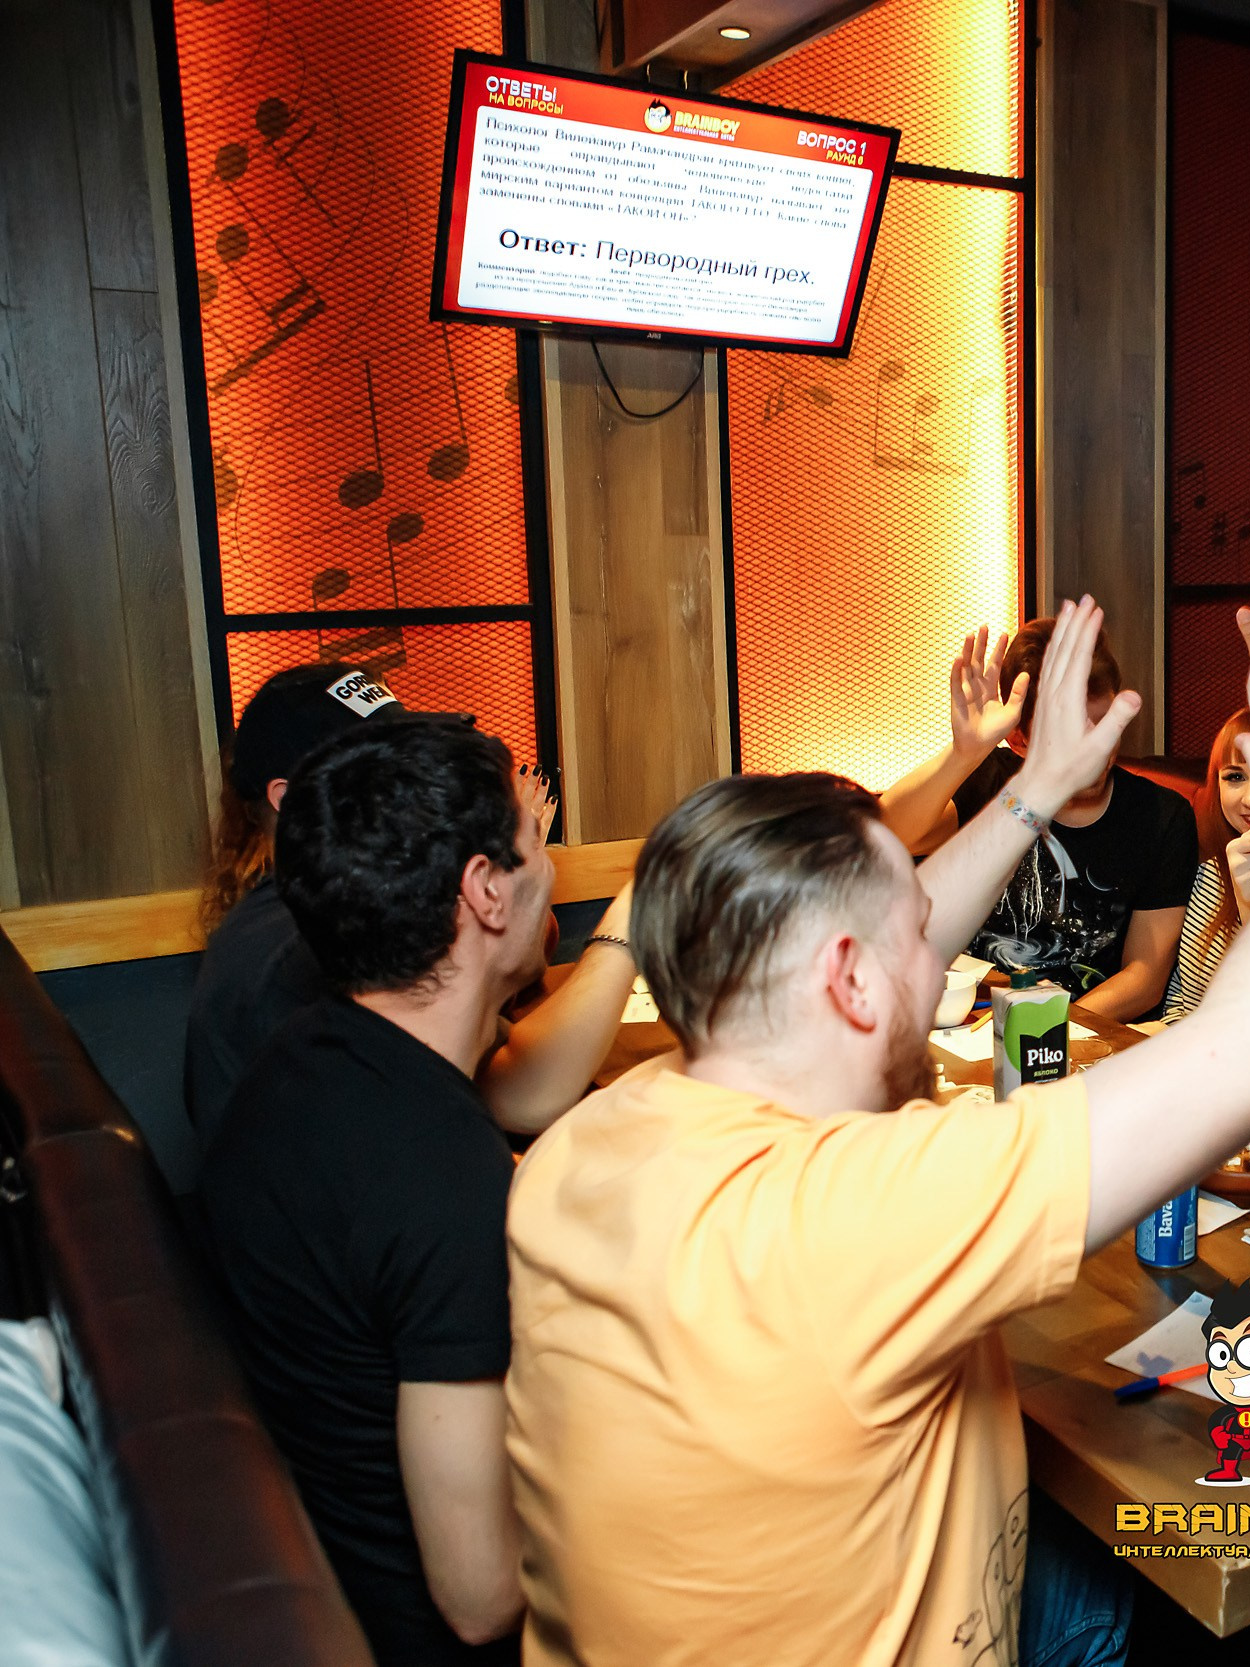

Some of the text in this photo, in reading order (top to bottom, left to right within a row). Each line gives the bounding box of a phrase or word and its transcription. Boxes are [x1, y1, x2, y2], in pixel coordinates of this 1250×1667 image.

[486, 76, 557, 102] ОТВЕТЫ
[489, 92, 564, 115] НА ВОПРОСЫ
[797, 130, 867, 155] ВОПРОС 1
[826, 150, 856, 165] РАУНД
[499, 228, 587, 257] Ответ:
[596, 240, 758, 279] Первородный
[764, 264, 816, 286] грех.
[1027, 1047, 1064, 1067] Piko
[1033, 1068, 1059, 1077] ЯБЛОКО
